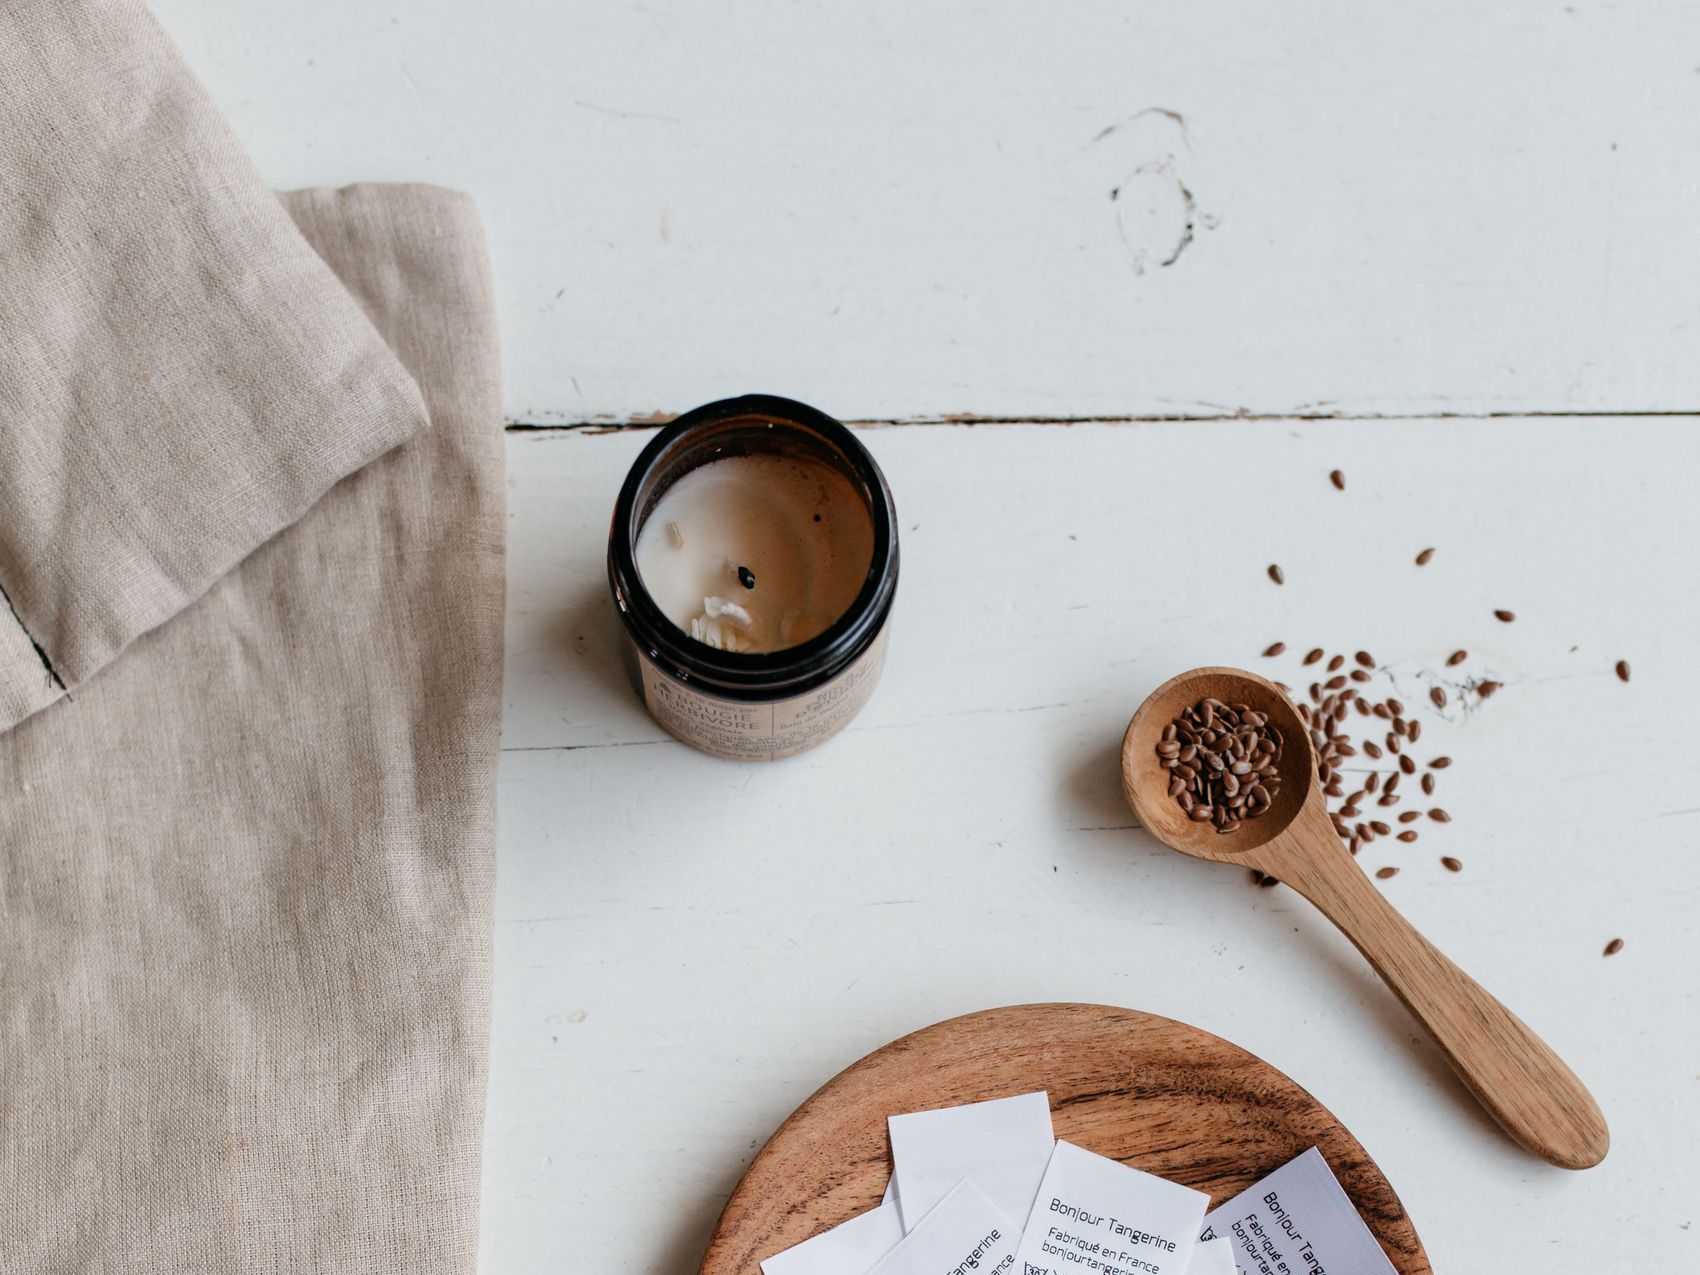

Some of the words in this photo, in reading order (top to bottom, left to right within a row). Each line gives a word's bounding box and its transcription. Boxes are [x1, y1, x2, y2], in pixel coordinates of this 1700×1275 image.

[654, 682, 760, 730] HERBIVORE
[678, 694, 752, 721] BOUGIE
[1050, 1198, 1104, 1226] Bonjour
[1109, 1218, 1176, 1252] Tangerine
[1245, 1214, 1283, 1262] Fabriqué
[1263, 1192, 1302, 1240] Bonjour
[1048, 1227, 1100, 1254] Fabriqué
[1102, 1247, 1117, 1260] en
[1118, 1253, 1160, 1274] France
